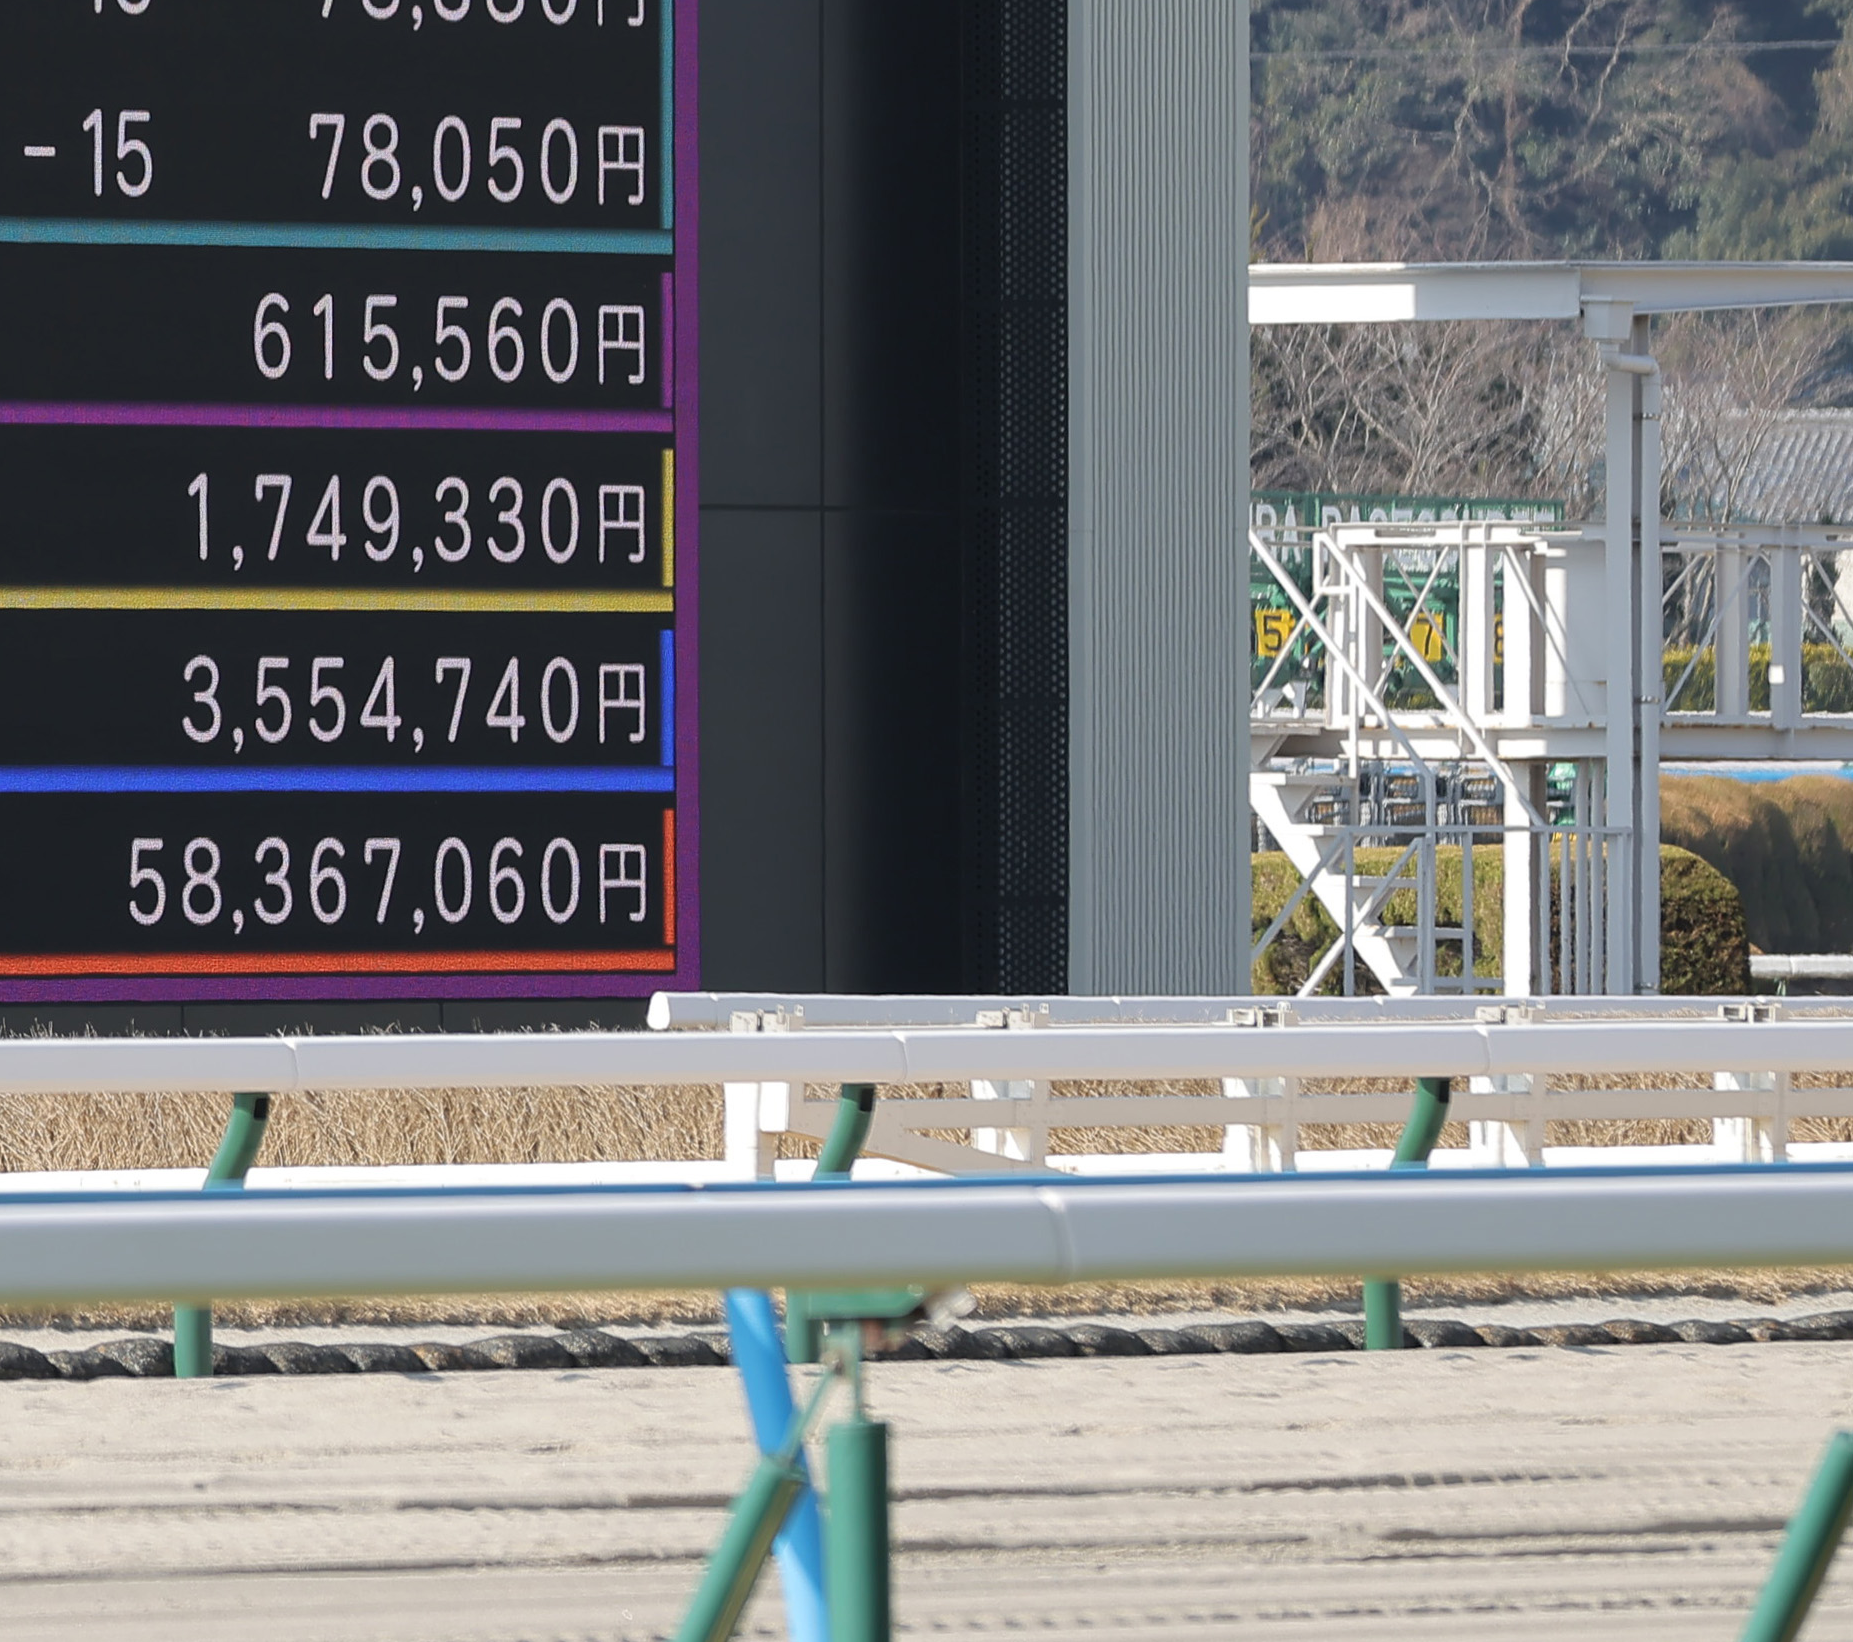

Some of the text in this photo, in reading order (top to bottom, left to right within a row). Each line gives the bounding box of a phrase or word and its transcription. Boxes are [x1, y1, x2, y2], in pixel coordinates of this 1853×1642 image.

[83, 109, 152, 196] 15
[310, 114, 644, 210] 78,050円
[255, 293, 644, 390] 615,560円
[189, 474, 644, 571] 1,749,330円
[1263, 613, 1282, 651] 5
[1415, 616, 1434, 656] 7
[183, 656, 644, 752] 3,554,740円
[130, 838, 645, 933] 58,367,060円
